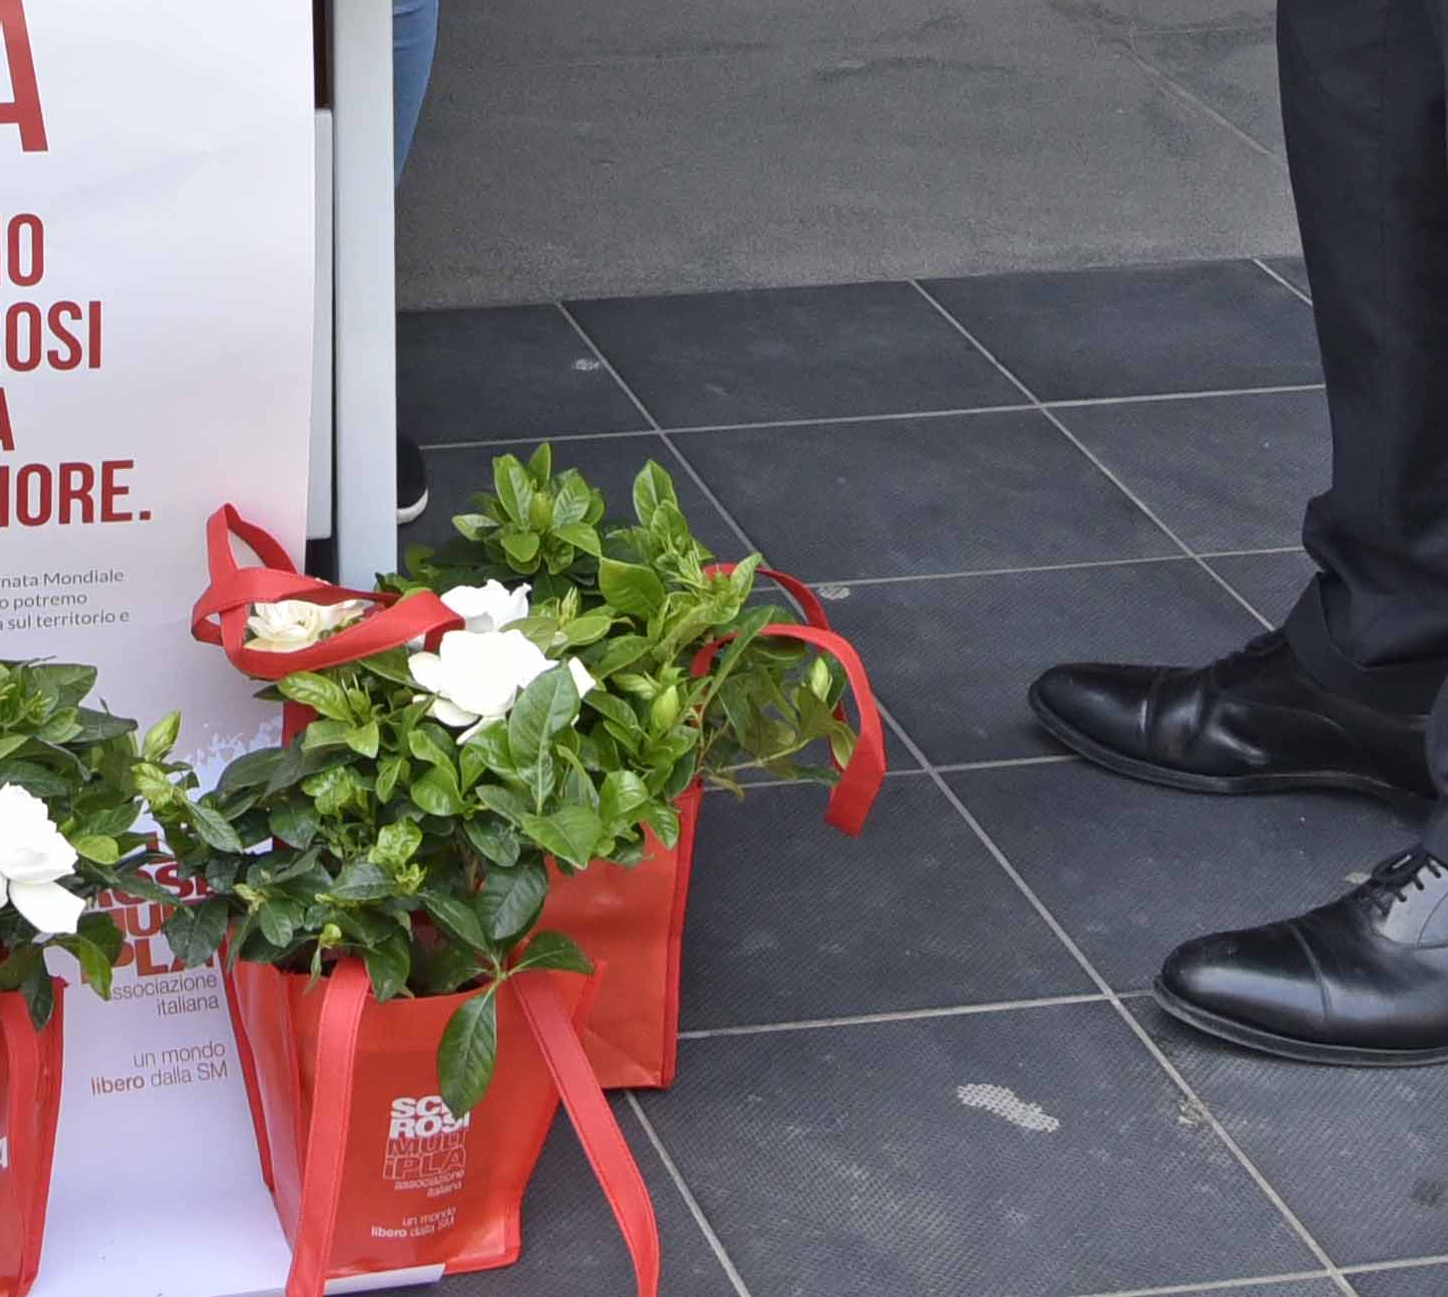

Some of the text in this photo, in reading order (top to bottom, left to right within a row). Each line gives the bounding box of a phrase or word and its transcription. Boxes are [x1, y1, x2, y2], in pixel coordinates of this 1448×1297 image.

[43, 568, 125, 586] Mondiale
[13, 592, 88, 612] potremo
[7, 613, 33, 630] sul
[36, 610, 115, 628] territorio
[119, 612, 130, 623] e
[113, 973, 217, 1001] ssociazione
[156, 992, 219, 1017] italiana
[133, 1040, 225, 1069] un mondo
[90, 1060, 228, 1095] libero dalla SM
[371, 1226, 407, 1238] libero
[410, 1224, 435, 1237] dalla
[402, 1215, 417, 1227] un
